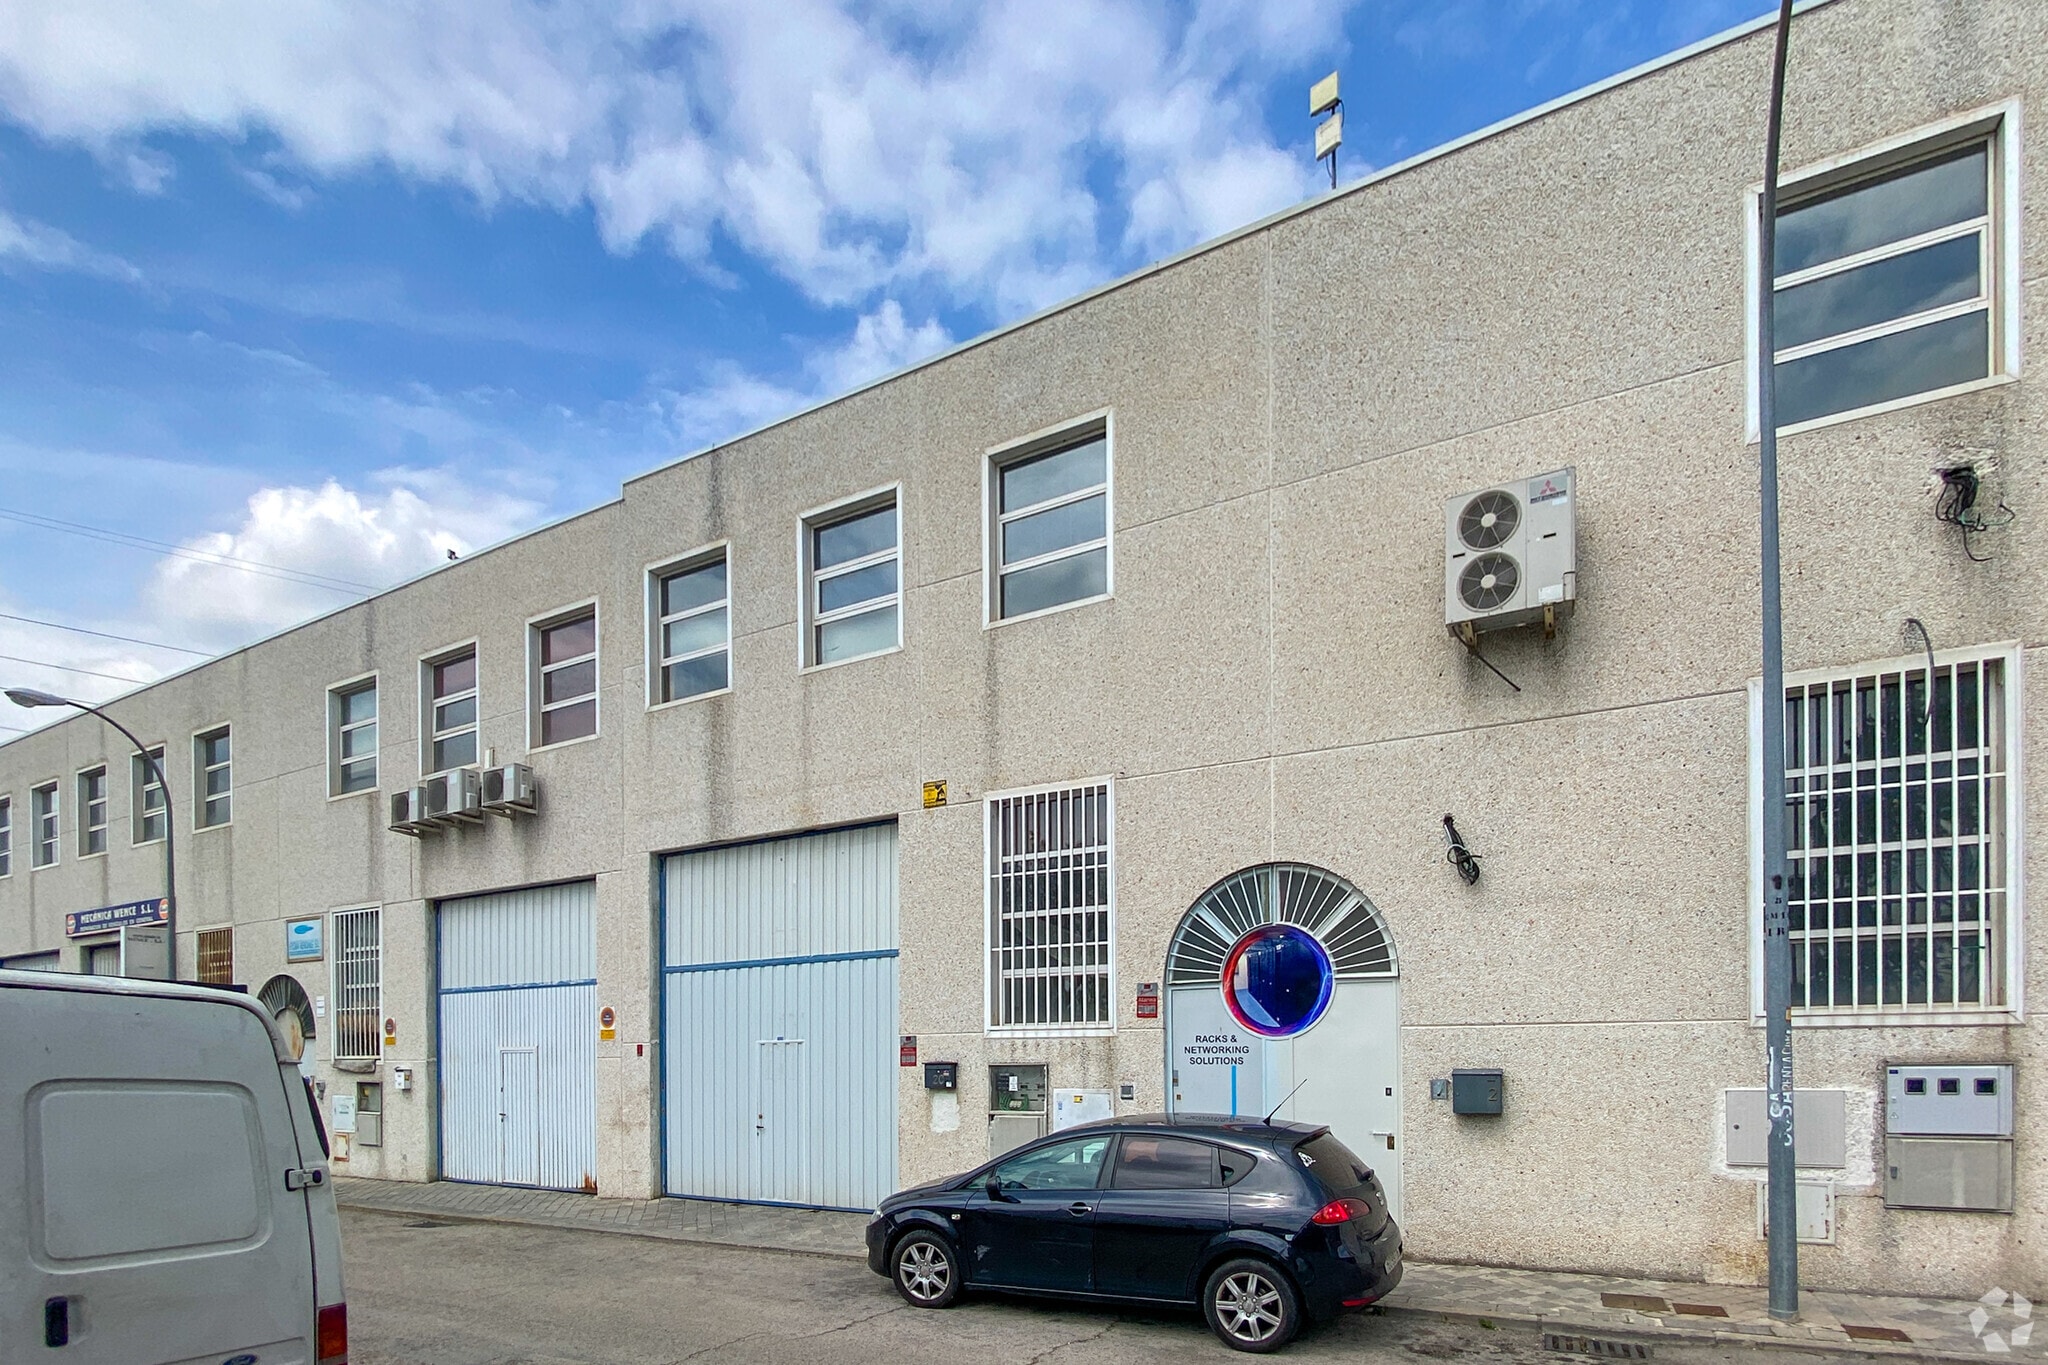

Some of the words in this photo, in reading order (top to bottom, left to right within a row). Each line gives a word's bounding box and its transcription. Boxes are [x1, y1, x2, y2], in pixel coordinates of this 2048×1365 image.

[141, 904, 154, 914] S.L.
[1195, 1035, 1228, 1043] RACKS
[1230, 1034, 1238, 1043] &
[1184, 1045, 1250, 1054] NETWORKING
[1189, 1056, 1244, 1065] SOLUTIONS
[932, 1074, 945, 1085] 20
[1488, 1088, 1498, 1102] 2
